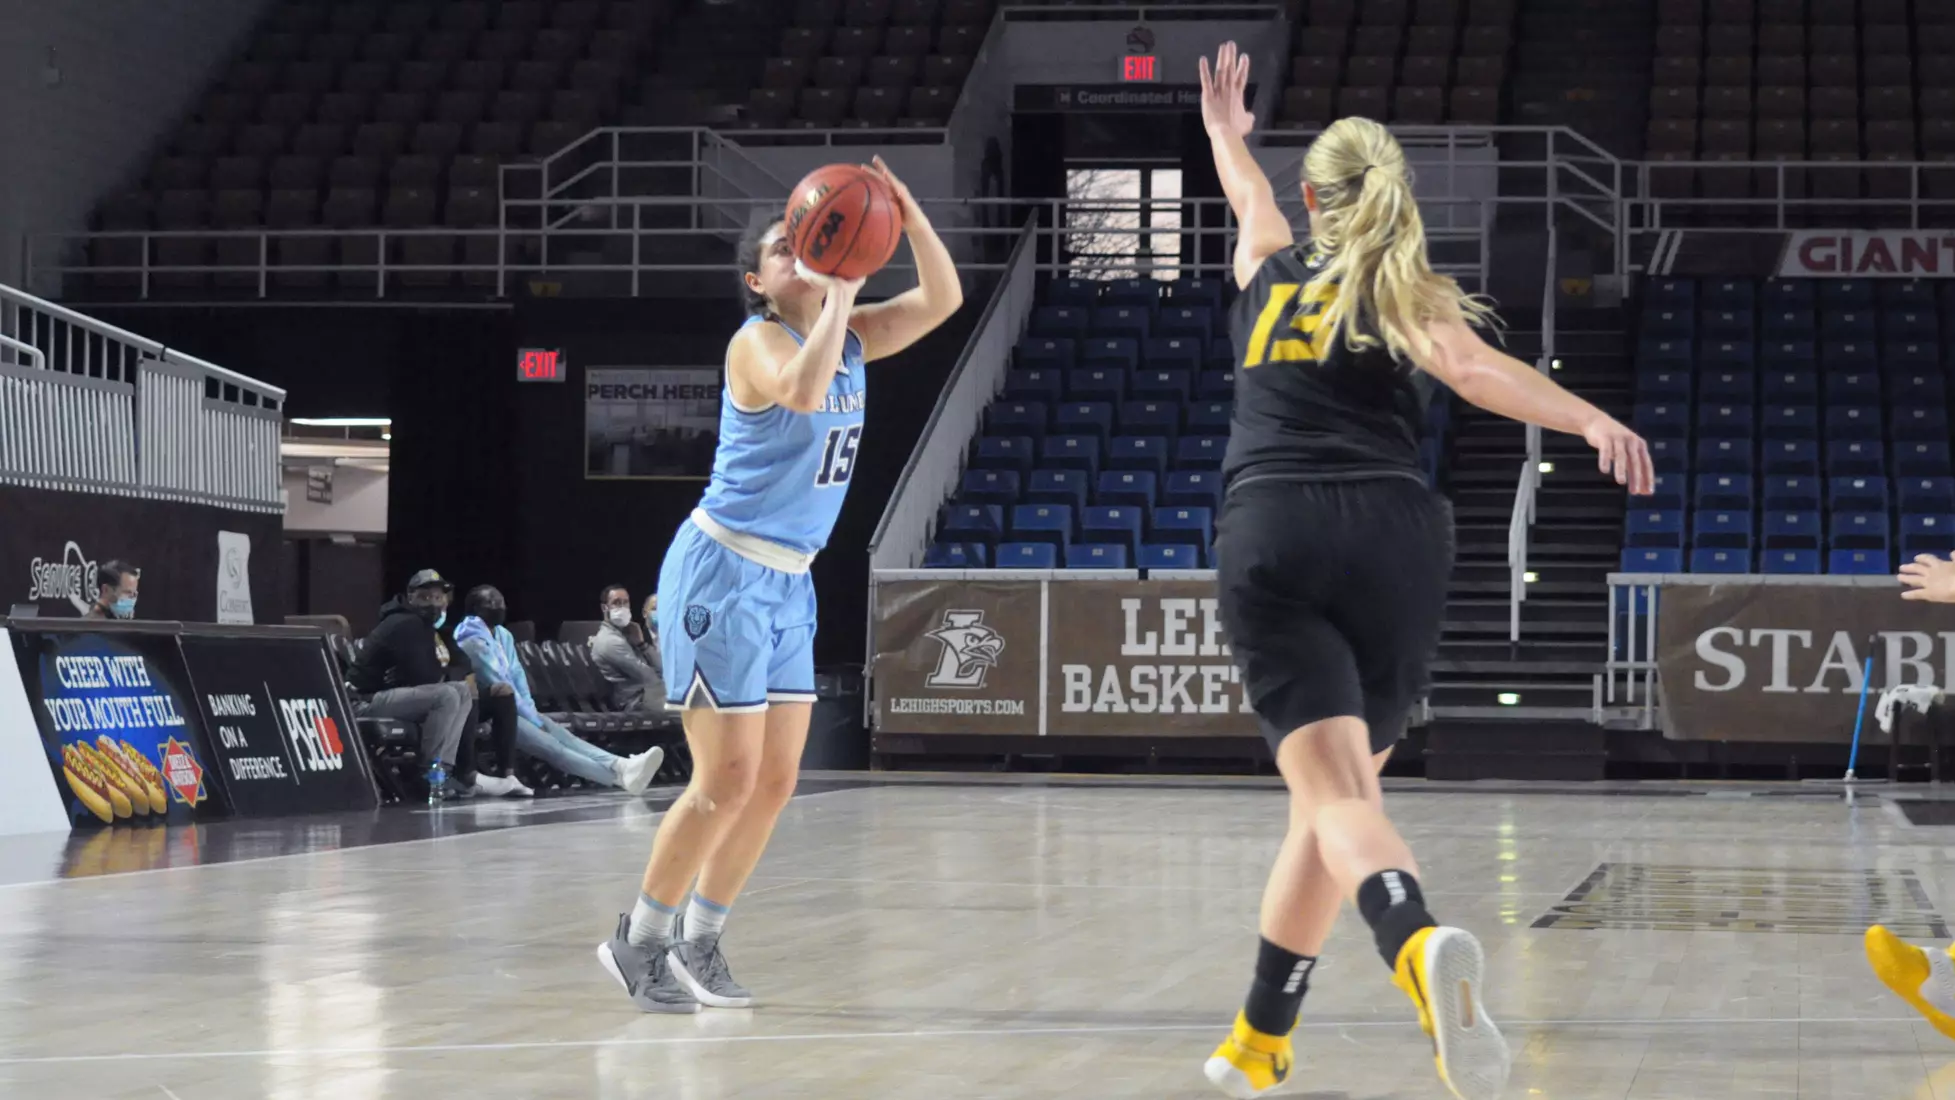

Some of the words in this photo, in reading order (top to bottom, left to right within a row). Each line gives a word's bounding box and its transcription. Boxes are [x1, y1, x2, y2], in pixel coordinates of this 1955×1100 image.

[1124, 56, 1155, 80] EXIT
[1077, 90, 1173, 105] Coordinated
[525, 351, 558, 378] EXIT
[588, 384, 657, 399] PERCH
[662, 384, 719, 399] HERE
[814, 424, 865, 488] 15
[55, 656, 110, 689] CHEER
[104, 656, 151, 687] WITH
[44, 698, 93, 731] YOUR
[86, 696, 146, 729] MOUTH
[141, 695, 185, 726] FULL.
[207, 694, 256, 716] BANKING
[890, 698, 1025, 715] LEHIGHSPORTS.COM
[219, 725, 239, 749] ON
[237, 725, 248, 748] A
[229, 756, 288, 780] DIFFERENCE.
